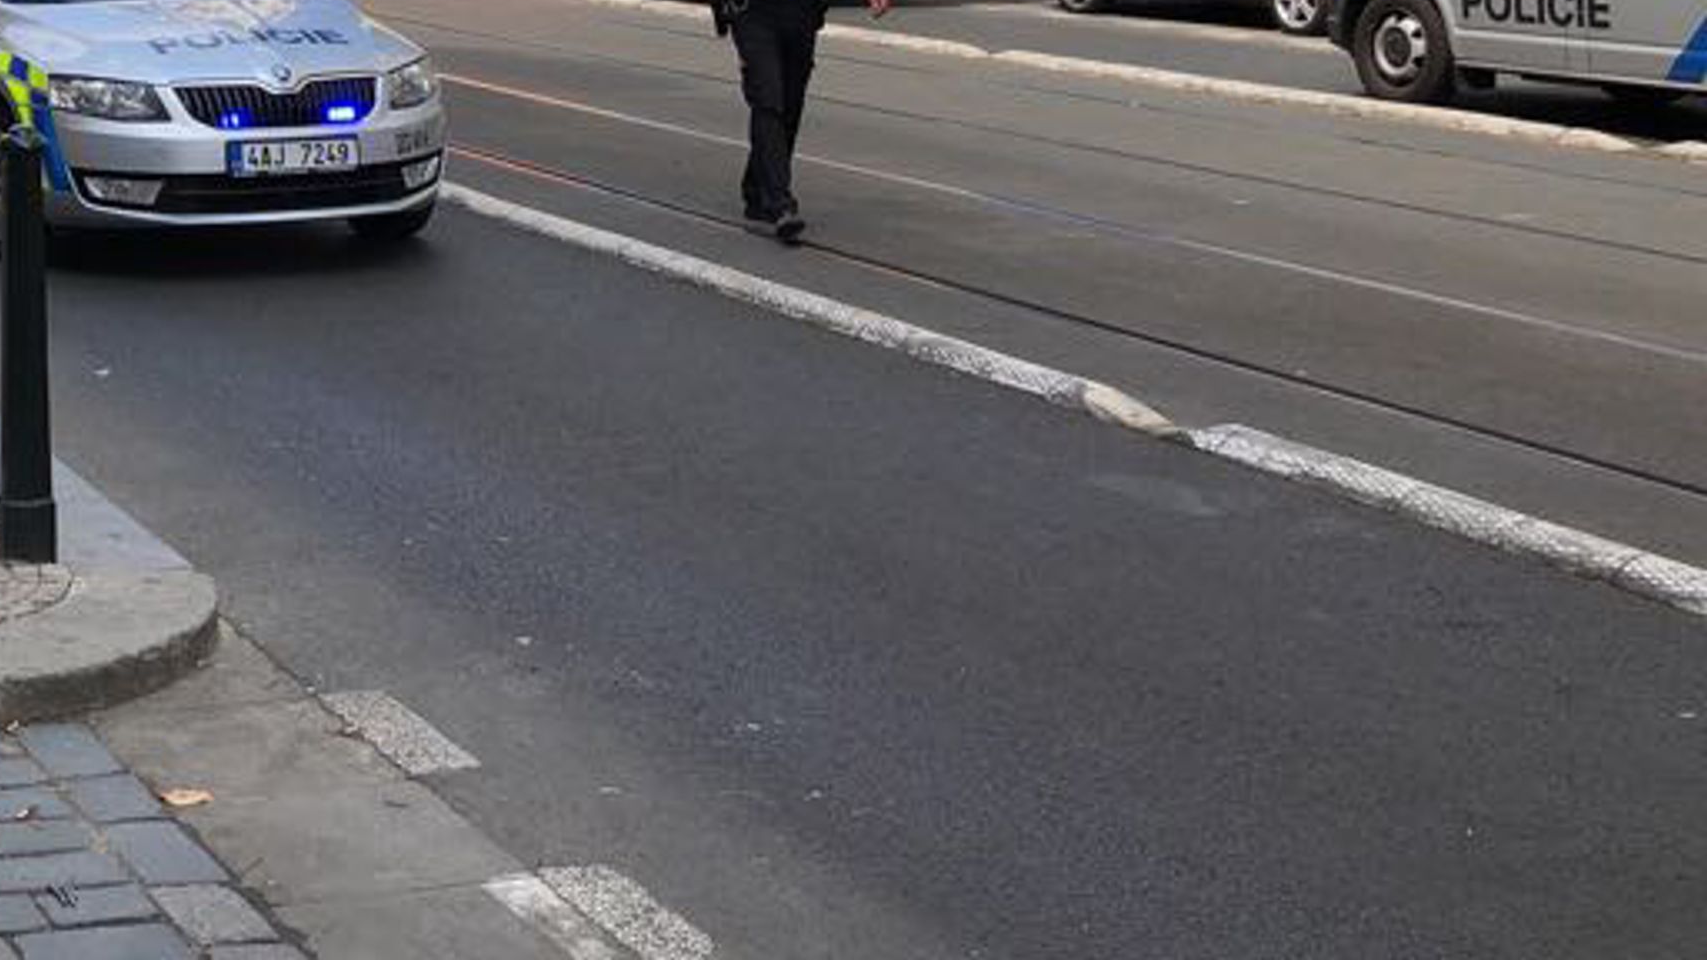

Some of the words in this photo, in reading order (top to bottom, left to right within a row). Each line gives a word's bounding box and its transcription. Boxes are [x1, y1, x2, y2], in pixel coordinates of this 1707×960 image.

[149, 28, 349, 54] POLICIE
[246, 145, 285, 167] 4AJ
[299, 142, 350, 167] 7249
